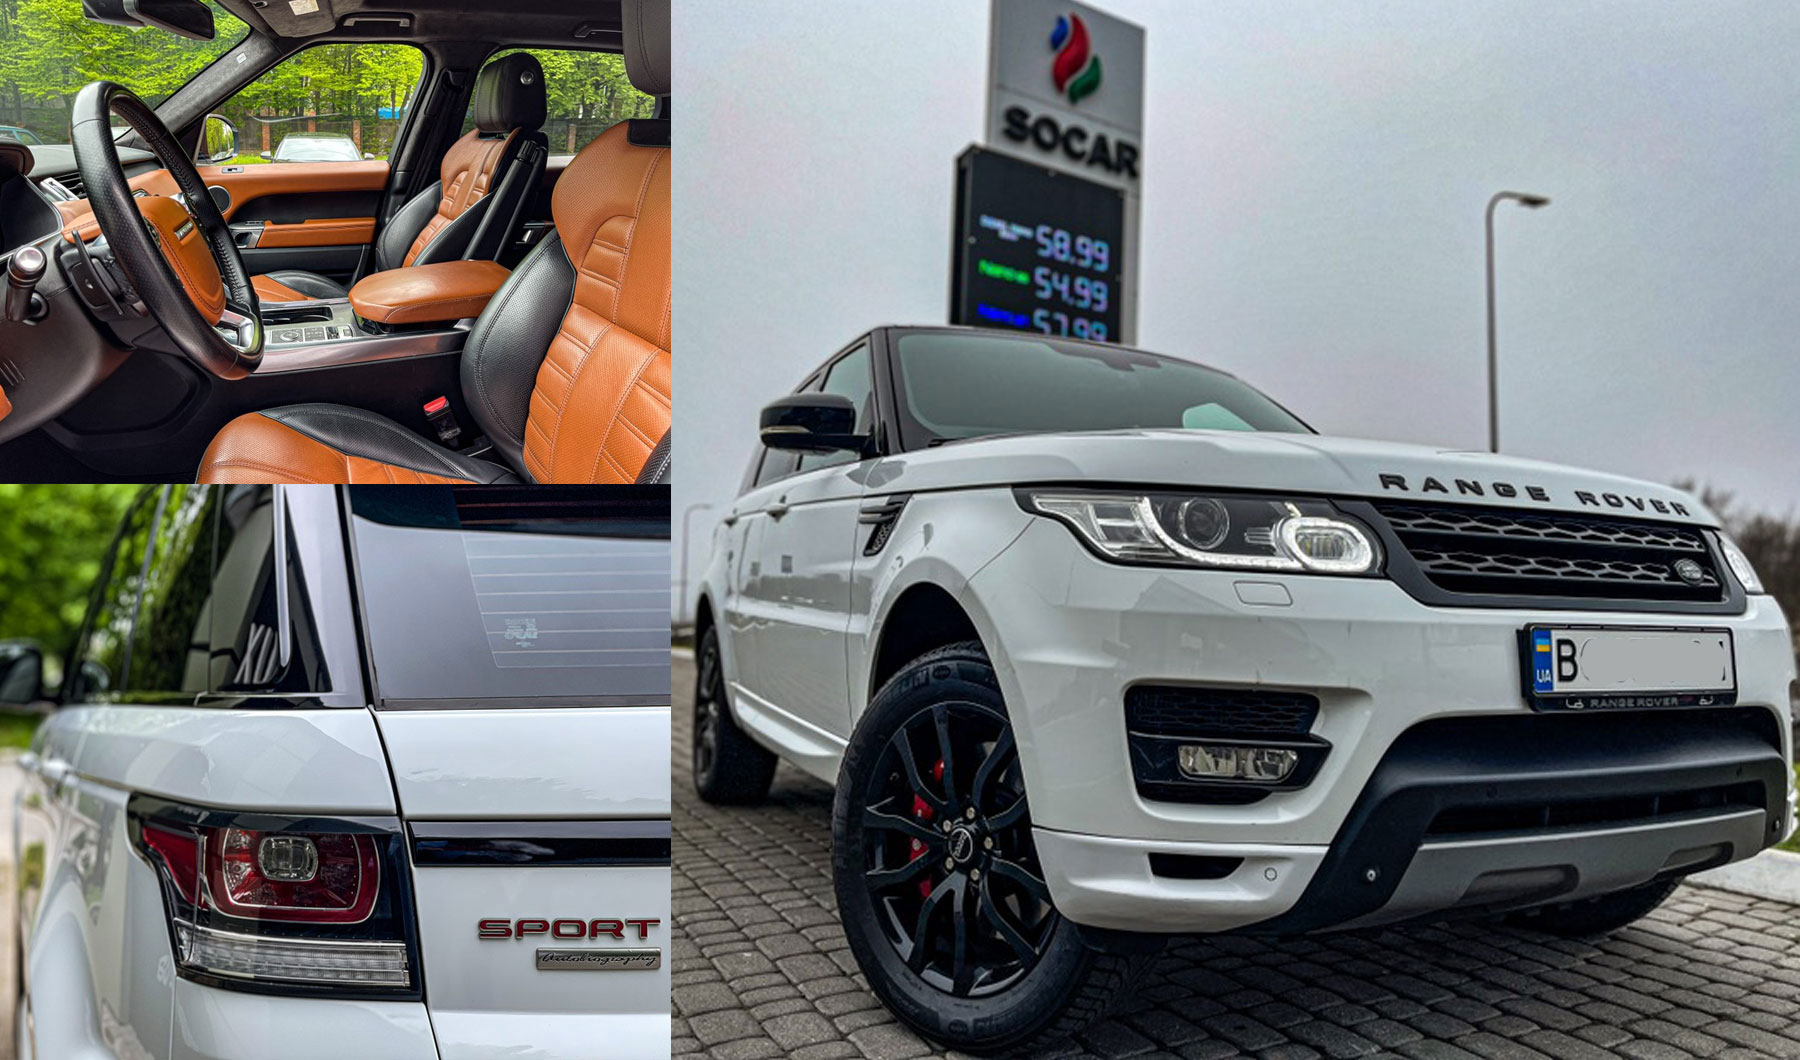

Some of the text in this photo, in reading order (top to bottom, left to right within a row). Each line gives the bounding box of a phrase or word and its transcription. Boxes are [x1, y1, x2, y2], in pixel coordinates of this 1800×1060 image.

[1002, 104, 1140, 180] SOCAR
[1035, 224, 1110, 273] 58.99
[1033, 265, 1109, 313] 54.99
[1032, 307, 1108, 342] 5799
[1378, 473, 1691, 517] RANGE ROVER
[1536, 669, 1552, 683] UA
[1590, 698, 1635, 708] RANGE
[1636, 696, 1679, 707] ROVER
[478, 918, 661, 940] SPORT
[541, 952, 657, 967] Autobiography
